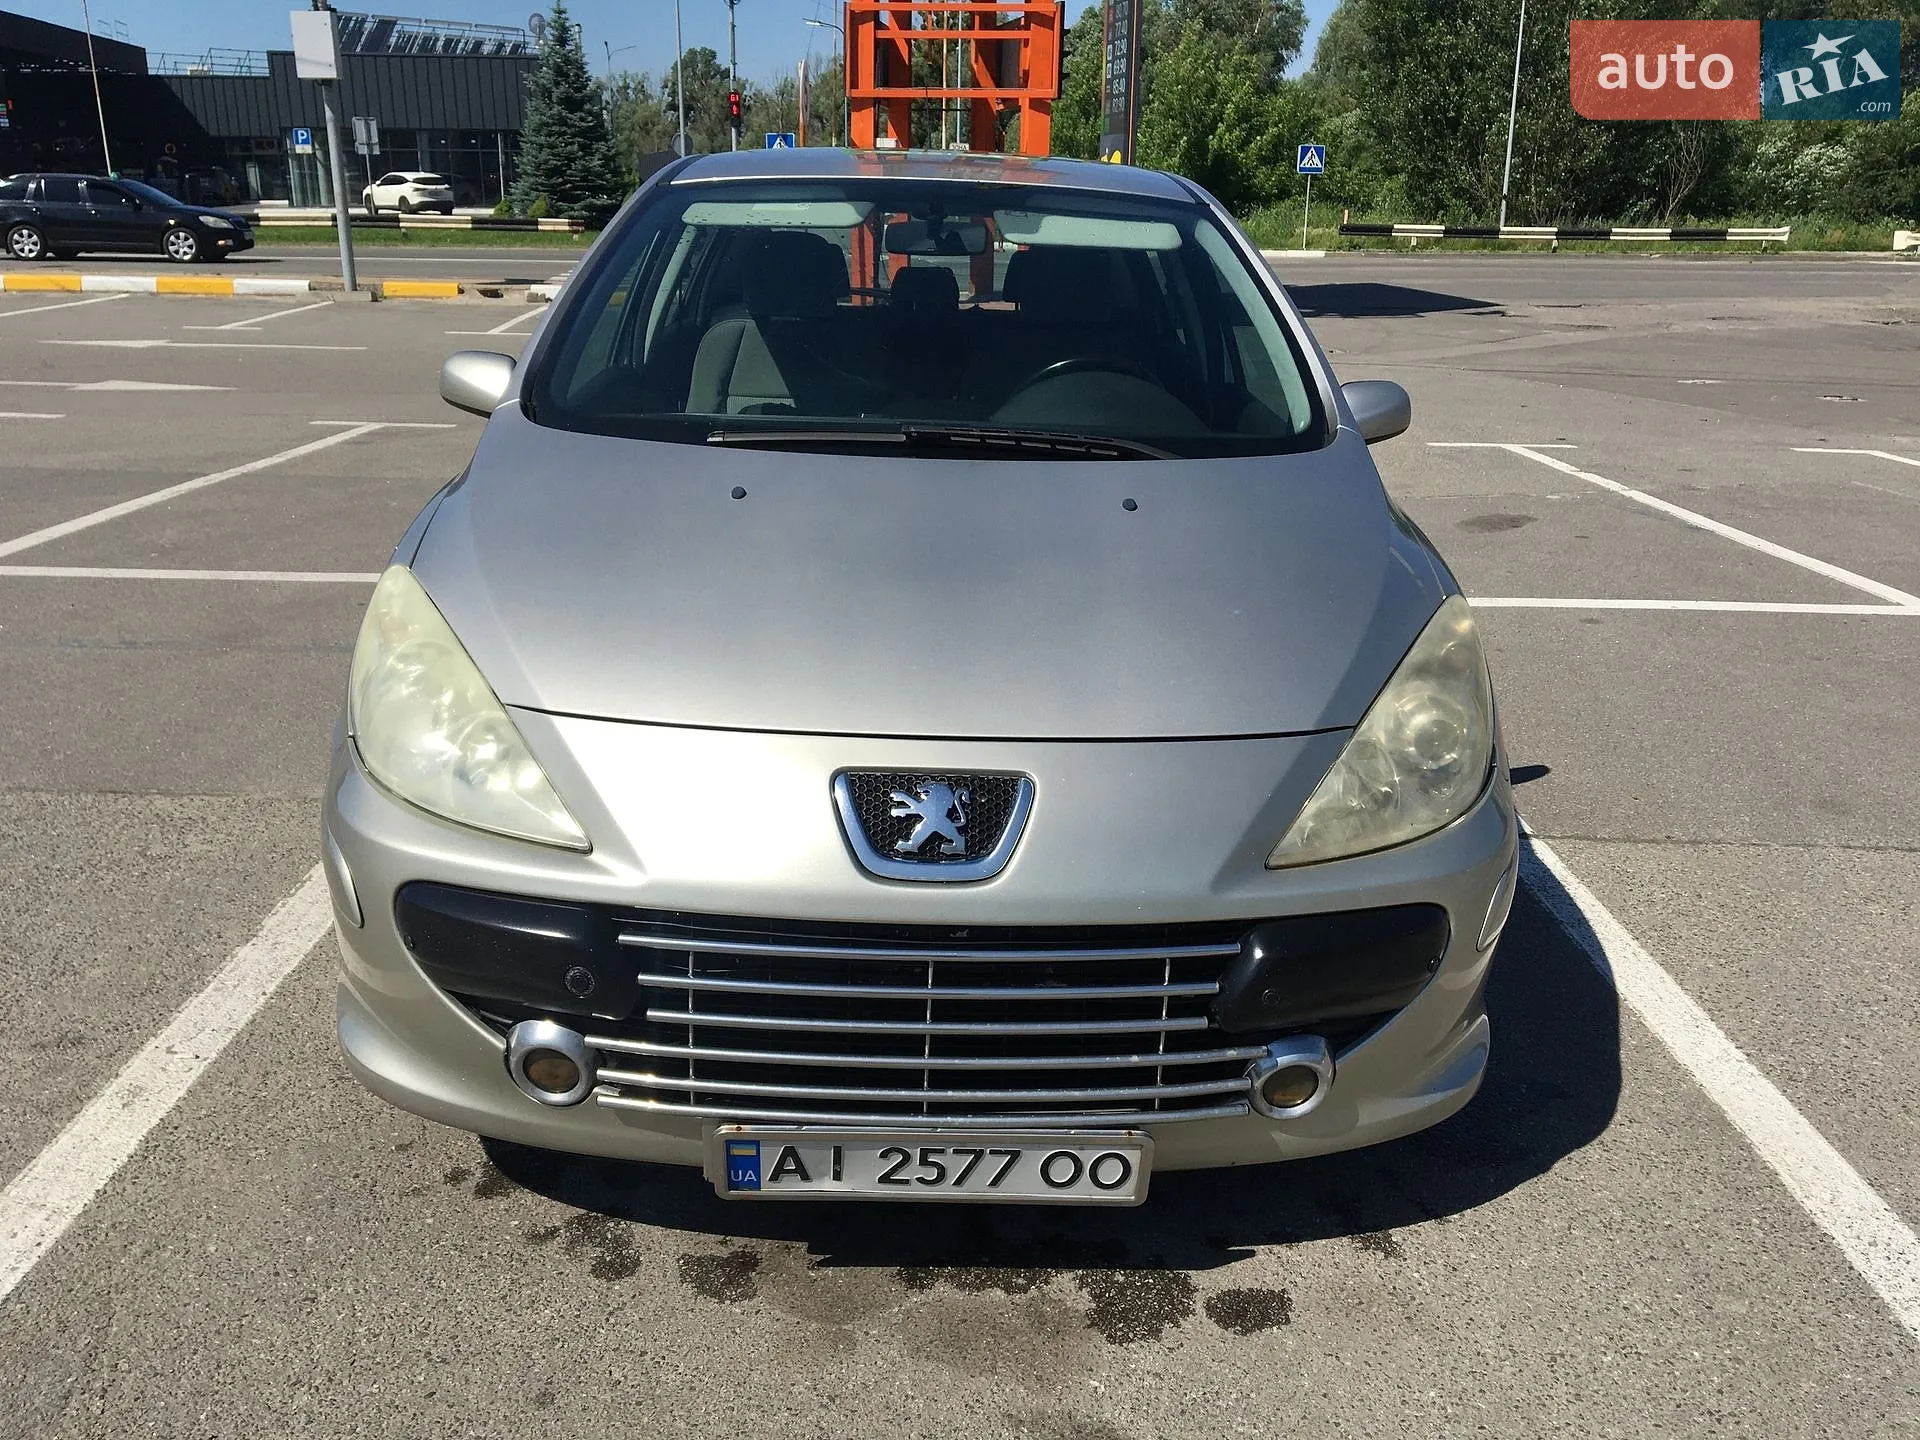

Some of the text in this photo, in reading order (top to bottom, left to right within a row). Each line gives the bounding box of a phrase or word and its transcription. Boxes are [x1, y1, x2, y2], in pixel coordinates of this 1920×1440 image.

[297, 130, 308, 144] P
[767, 1145, 1132, 1190] AI 2577 OO
[730, 1169, 757, 1182] UA
